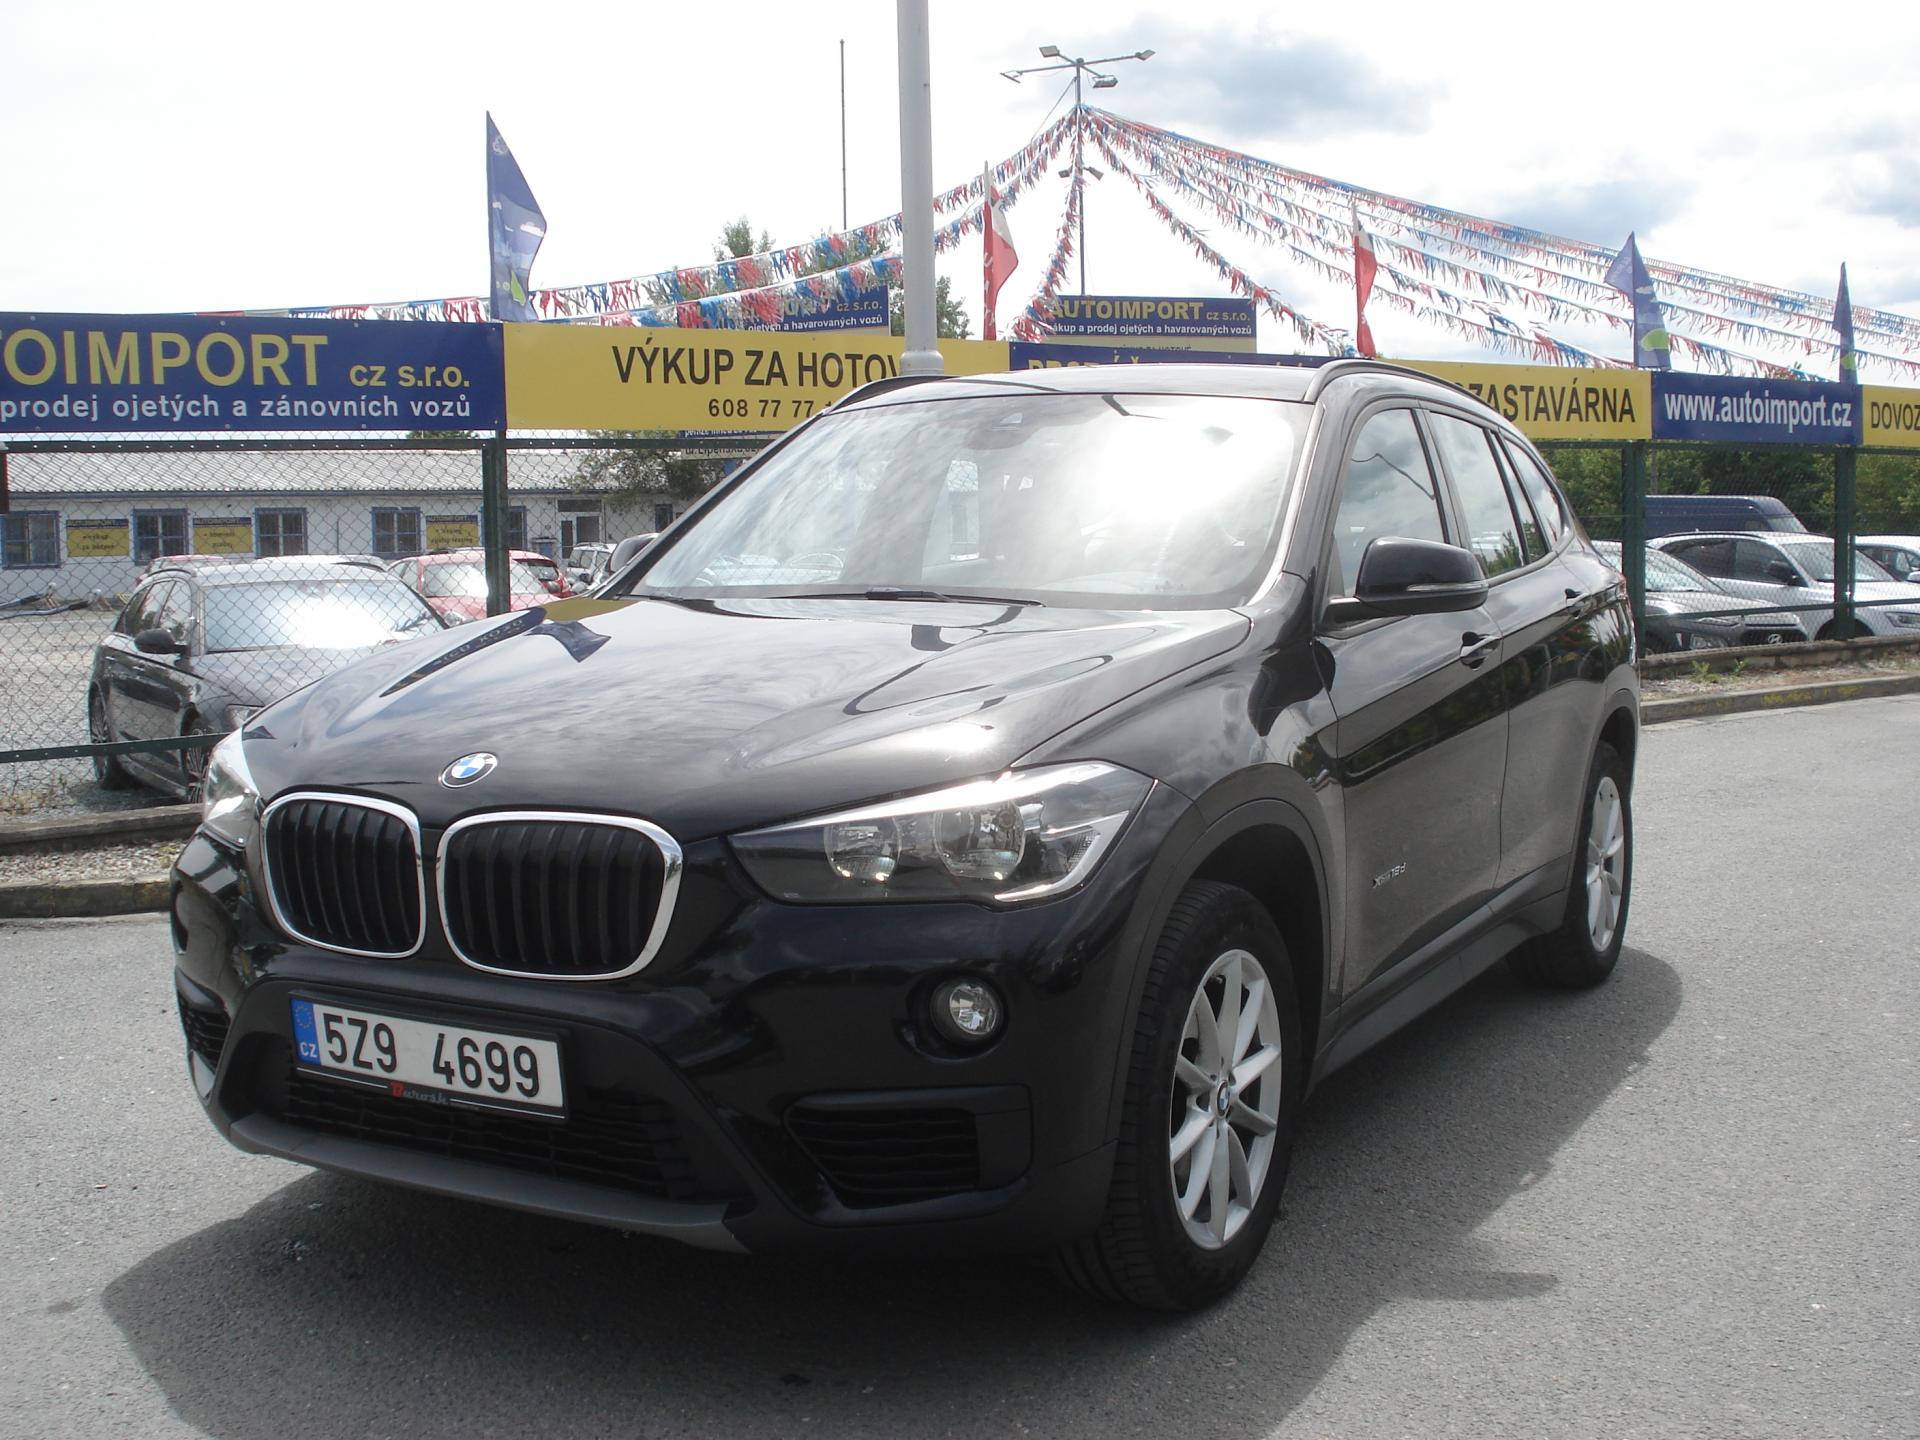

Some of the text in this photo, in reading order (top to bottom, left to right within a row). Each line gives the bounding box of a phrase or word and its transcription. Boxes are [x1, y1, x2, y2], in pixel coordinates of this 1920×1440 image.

[836, 301, 884, 312] cz s.r.o.
[1052, 300, 1251, 322] AUTOIMPORT cz s.r.o.
[783, 323, 790, 331] a
[791, 317, 862, 330] havarovaných
[1078, 325, 1085, 333] a
[1087, 323, 1118, 335] prodej
[1119, 323, 1154, 335] ojetých
[1156, 326, 1162, 334] a
[1164, 324, 1229, 336] havarovaných
[1228, 325, 1252, 335] vozů
[0, 328, 471, 389] OIMPORT cz s.r.o.
[612, 337, 734, 386] VÝKUP
[744, 349, 789, 387] ZA
[0, 394, 472, 423] prodej ojetých a zánovních vozů
[708, 398, 815, 420] 608 77 77
[1664, 390, 1853, 434] www.autoimport.cz
[299, 1041, 318, 1059] CZ
[322, 1012, 541, 1099] 5Z9 4699
